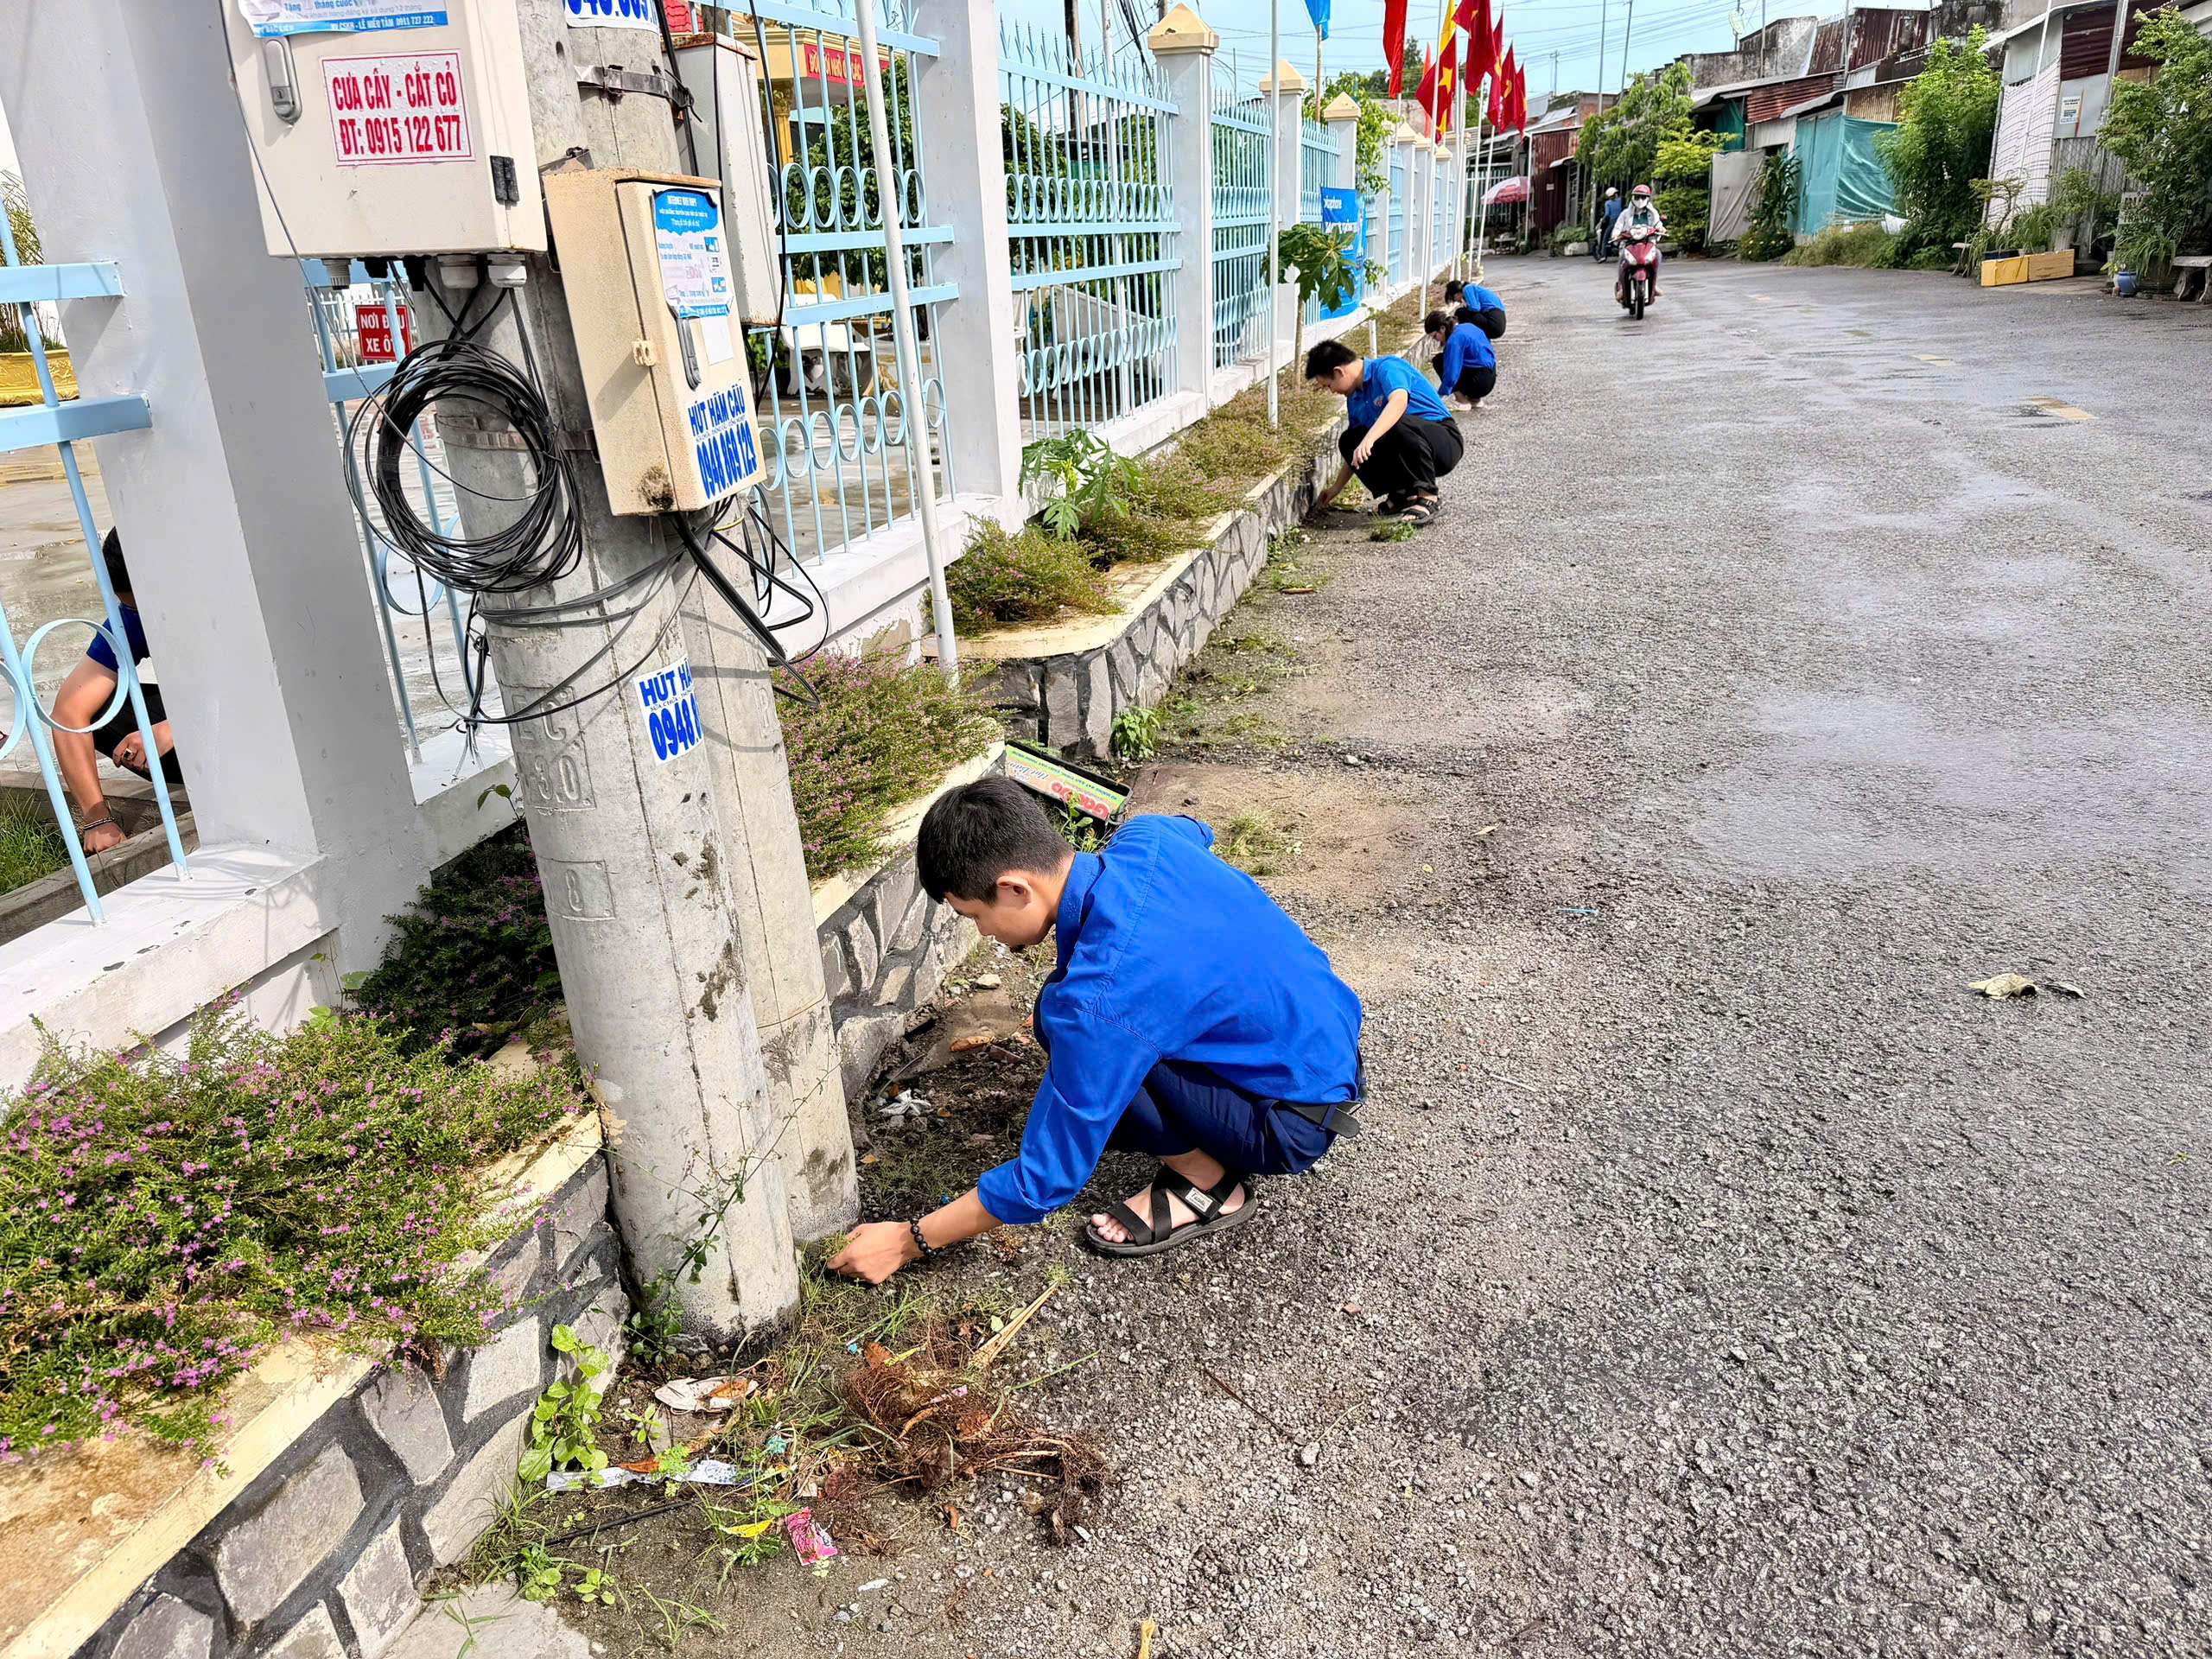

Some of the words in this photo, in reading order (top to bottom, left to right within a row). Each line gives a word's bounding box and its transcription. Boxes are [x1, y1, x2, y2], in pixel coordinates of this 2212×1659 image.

[333, 72, 363, 111] CƯA
[364, 68, 391, 110] CÂY
[405, 61, 432, 108] CẮT
[435, 60, 457, 106] CỎ
[339, 118, 364, 155] ĐT:
[365, 118, 403, 155] 0915
[404, 116, 433, 153] 122
[435, 115, 461, 152] 677
[359, 312, 379, 329] NƠI
[381, 314, 405, 330] ĐU
[365, 338, 380, 353] XE
[688, 400, 709, 436] HÚT
[707, 391, 729, 428] HẦM
[727, 384, 746, 418] CẦU
[639, 671, 677, 707] HÚT
